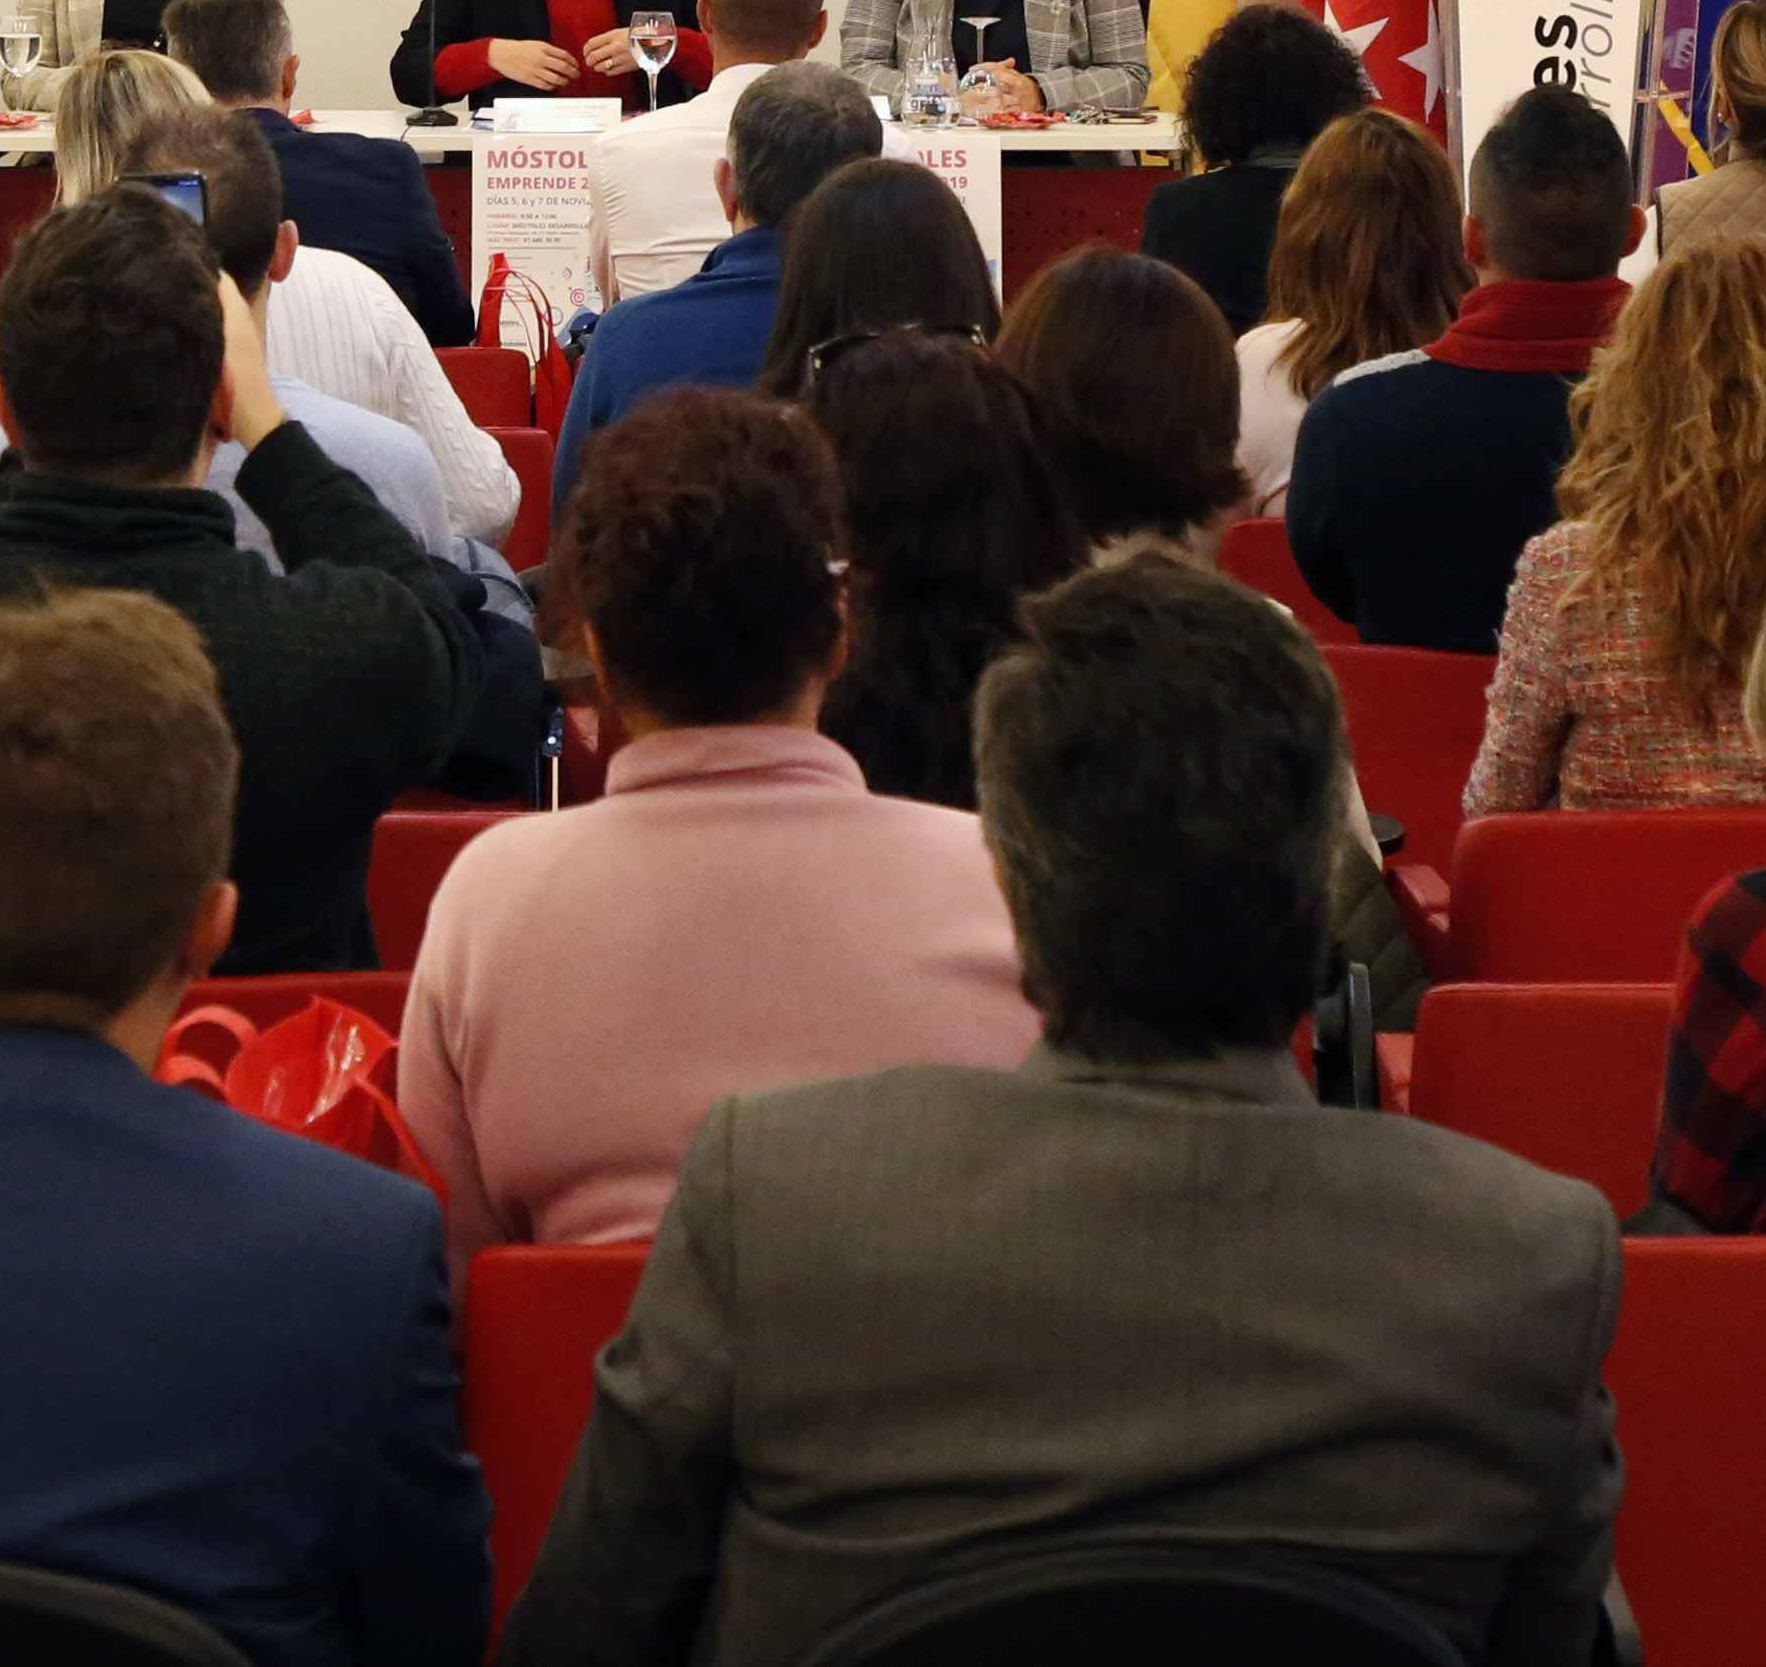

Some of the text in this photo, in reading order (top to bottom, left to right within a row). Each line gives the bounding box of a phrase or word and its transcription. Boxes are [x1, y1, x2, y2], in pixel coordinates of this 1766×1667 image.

[487, 177, 576, 189] EMPRENDE
[487, 196, 508, 205] DÍAS
[512, 197, 519, 206] 5,
[522, 197, 527, 205] 6
[530, 199, 535, 207] y
[538, 197, 543, 205] 7
[547, 197, 559, 205] DE
